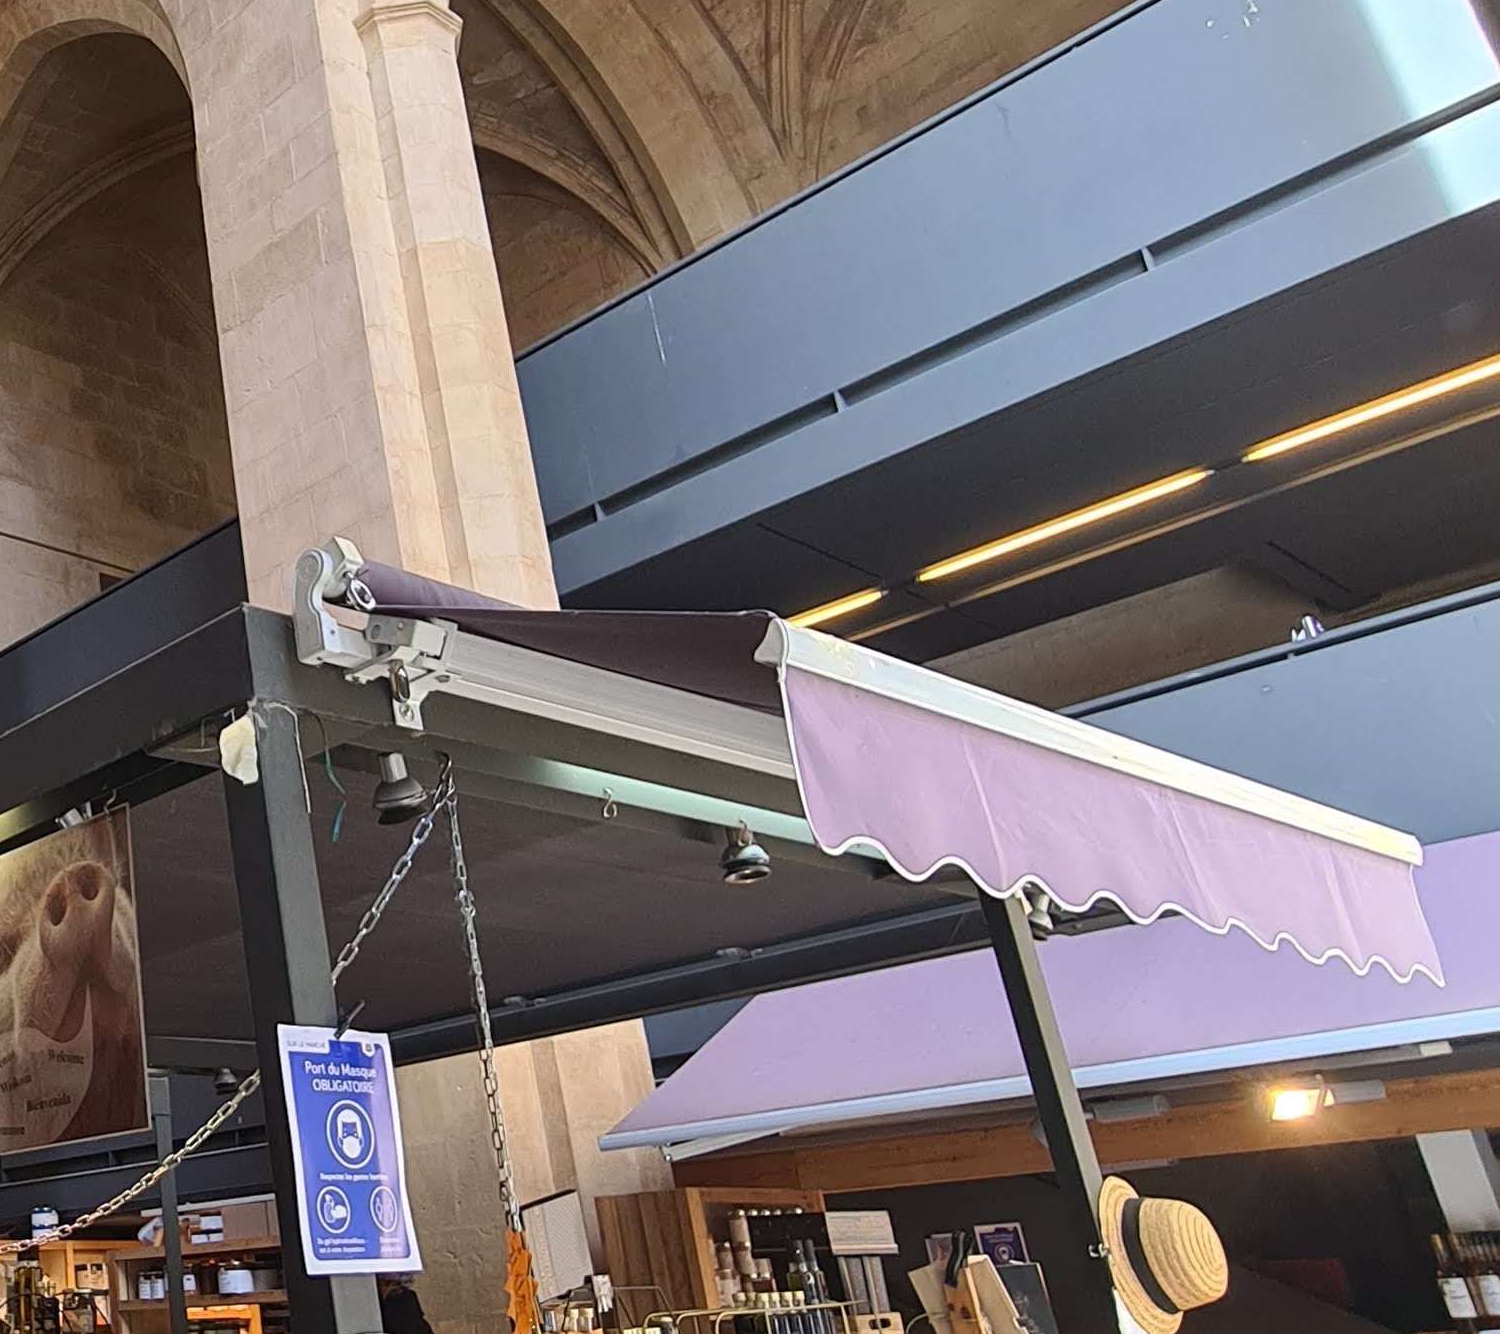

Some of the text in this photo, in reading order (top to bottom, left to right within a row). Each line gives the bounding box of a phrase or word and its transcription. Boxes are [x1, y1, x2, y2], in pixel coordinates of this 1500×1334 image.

[304, 1060, 378, 1081] Port du Masque
[312, 1078, 376, 1094] OBLIGATOIRE
